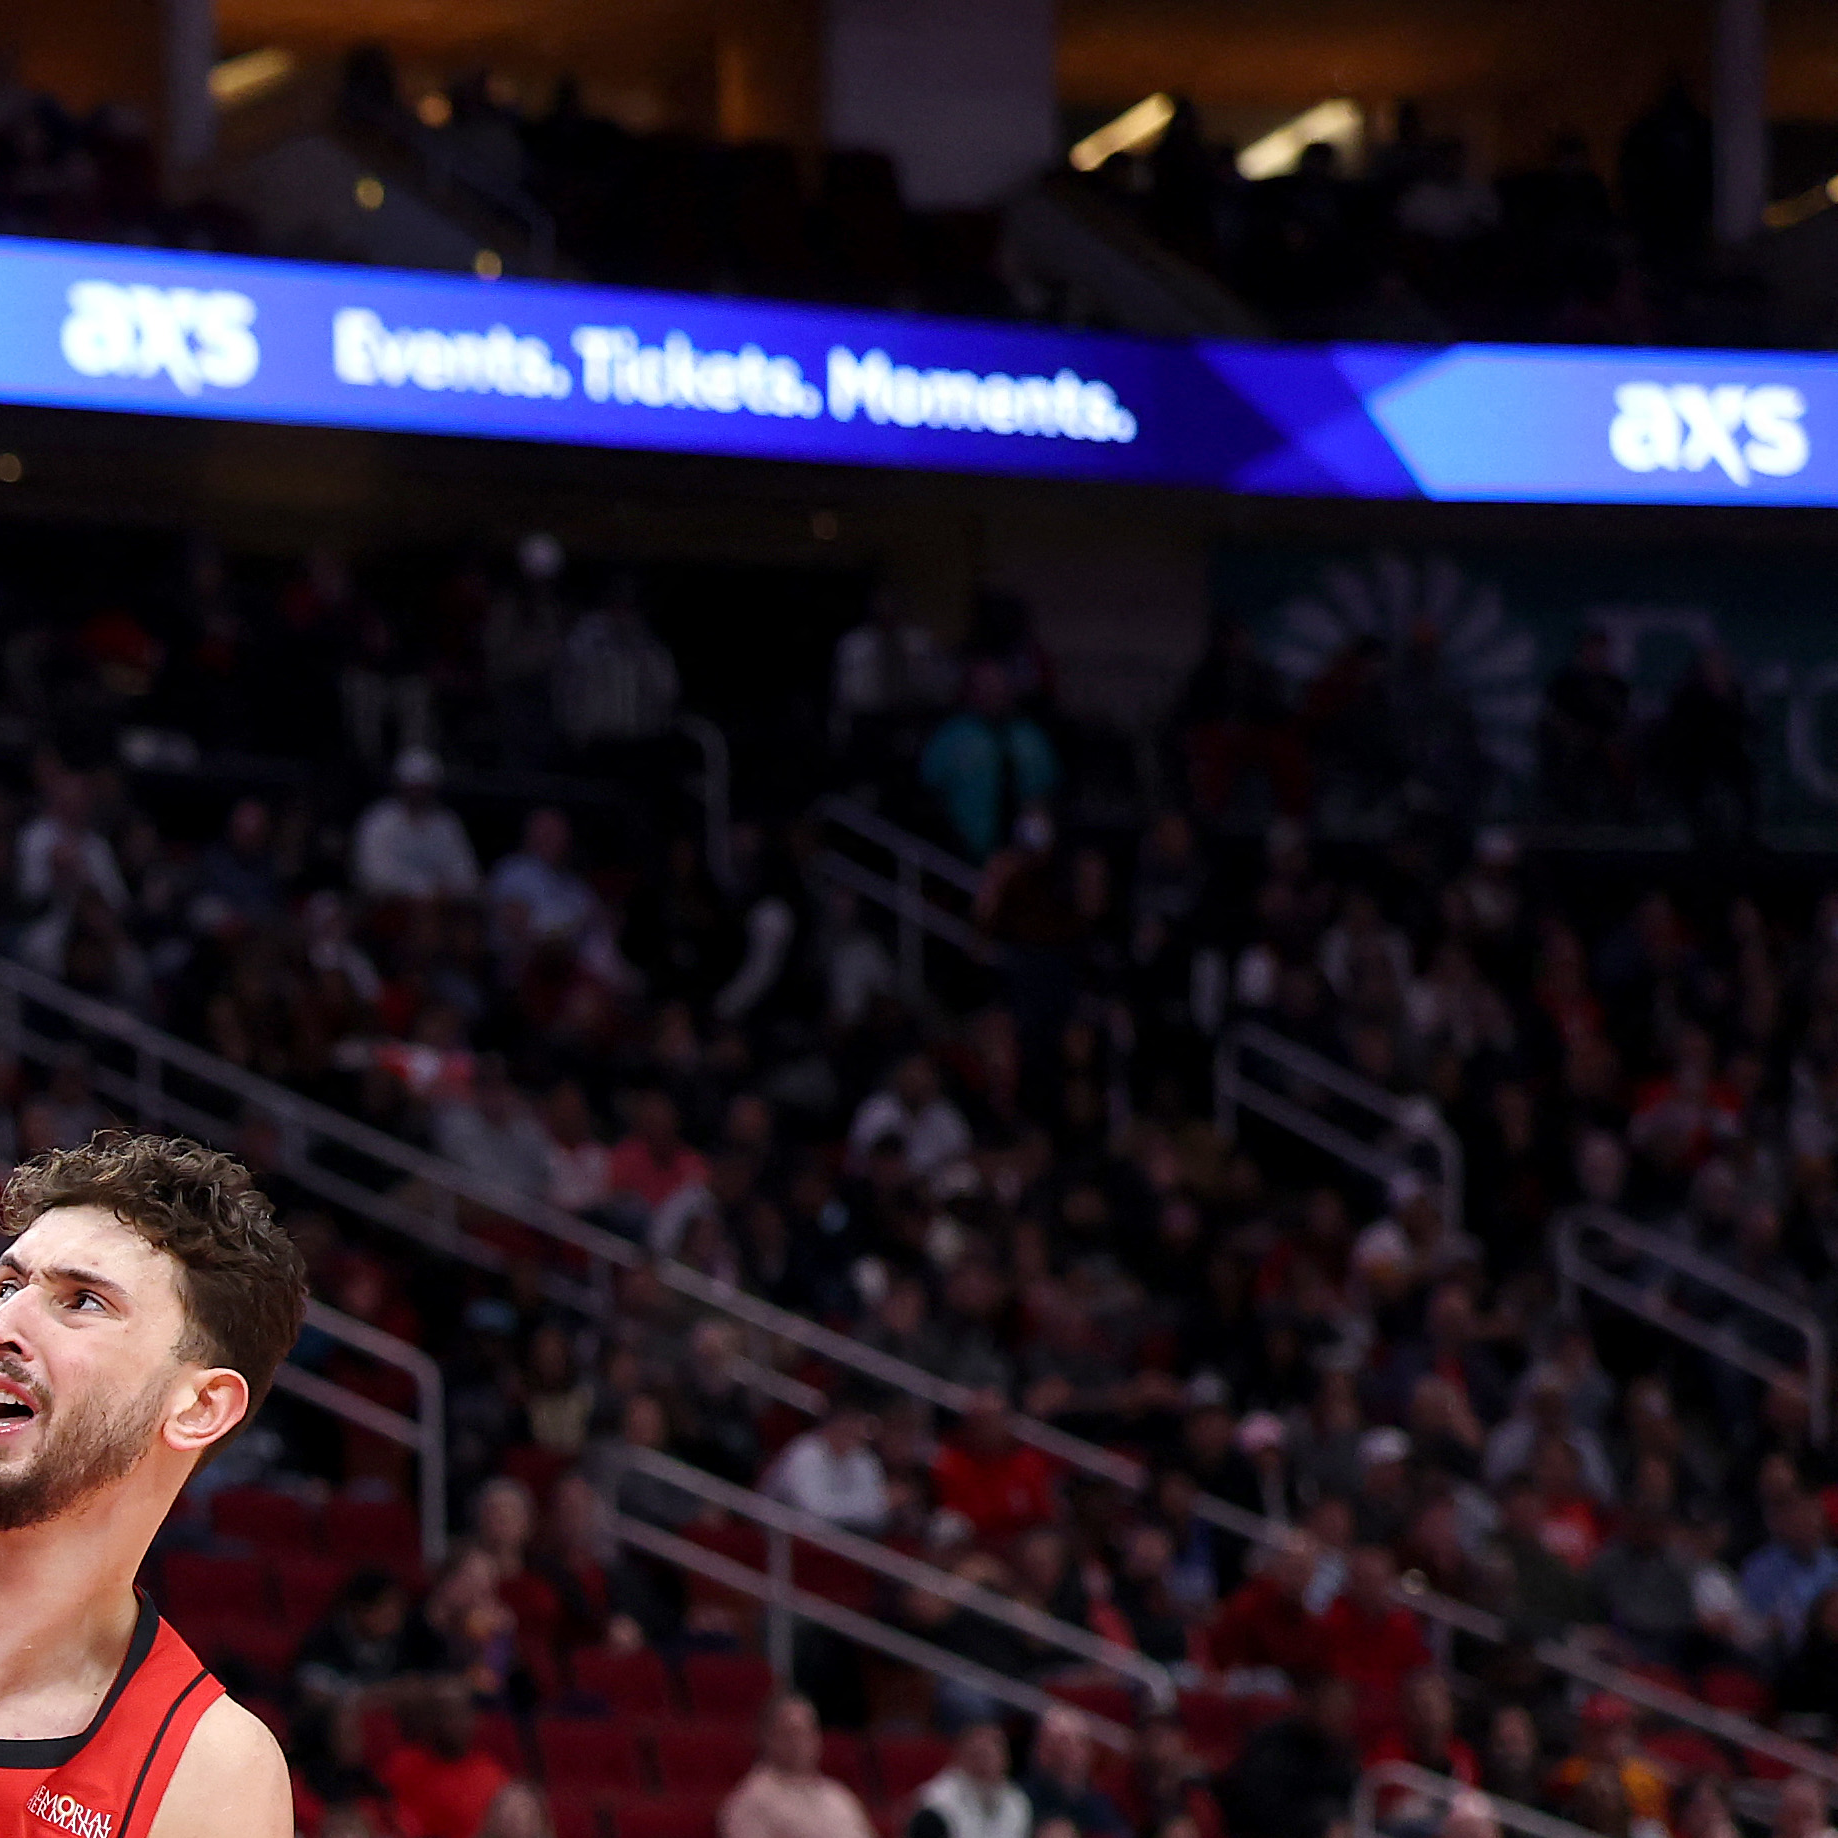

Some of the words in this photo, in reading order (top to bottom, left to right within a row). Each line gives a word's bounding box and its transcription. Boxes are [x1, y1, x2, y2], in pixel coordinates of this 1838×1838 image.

[60, 279, 259, 392] axs
[333, 307, 573, 400] Events.
[572, 326, 825, 419] Tickets.
[827, 346, 1138, 443] Moments.
[1608, 381, 1811, 488] axs
